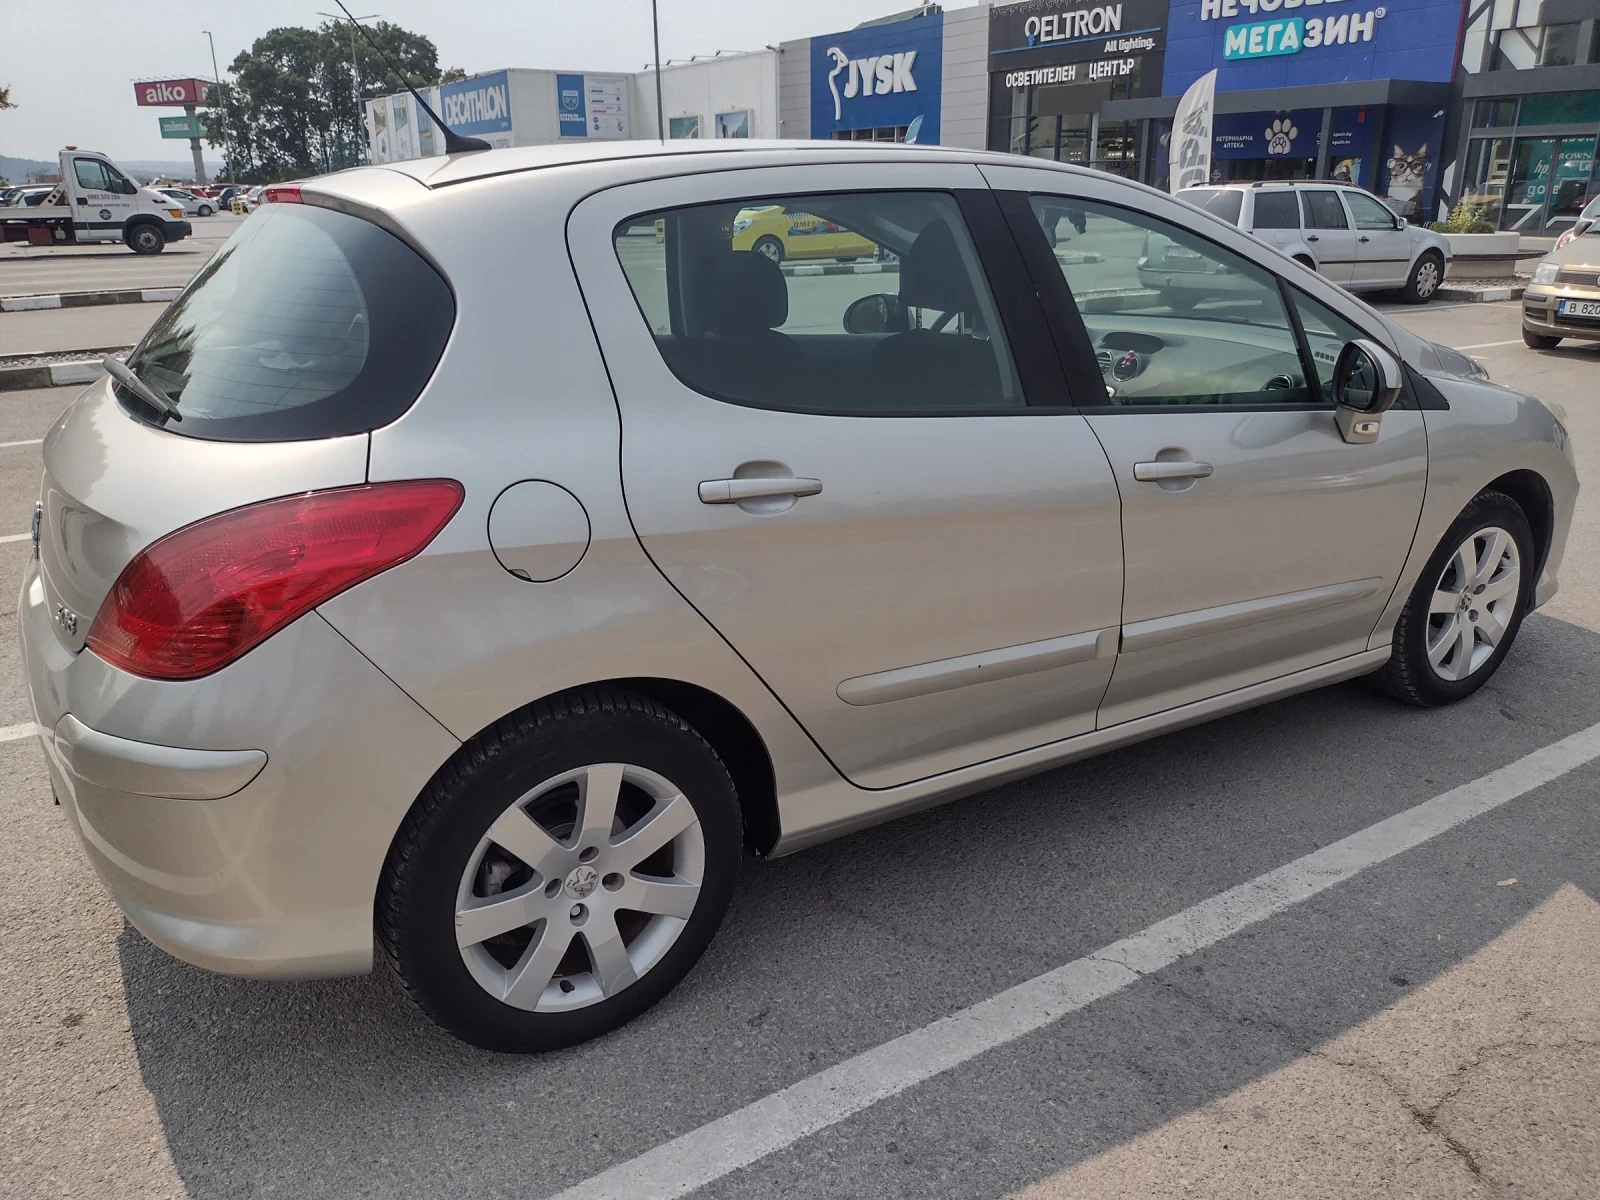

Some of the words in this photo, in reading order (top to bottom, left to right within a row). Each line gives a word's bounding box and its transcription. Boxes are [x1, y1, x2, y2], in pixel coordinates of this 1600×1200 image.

[1024, 4, 1122, 43] OELTRON
[1225, 11, 1374, 56] МЕГАЗИН
[1104, 41, 1118, 53] All
[844, 51, 918, 98] JYSK
[1005, 65, 1076, 88] ОСВЕТИТЕЛЕН
[1088, 58, 1135, 80] ЦЕНТЪР
[145, 83, 186, 103] aiko
[444, 84, 508, 127] DECATHLON
[1533, 159, 1550, 179] hp
